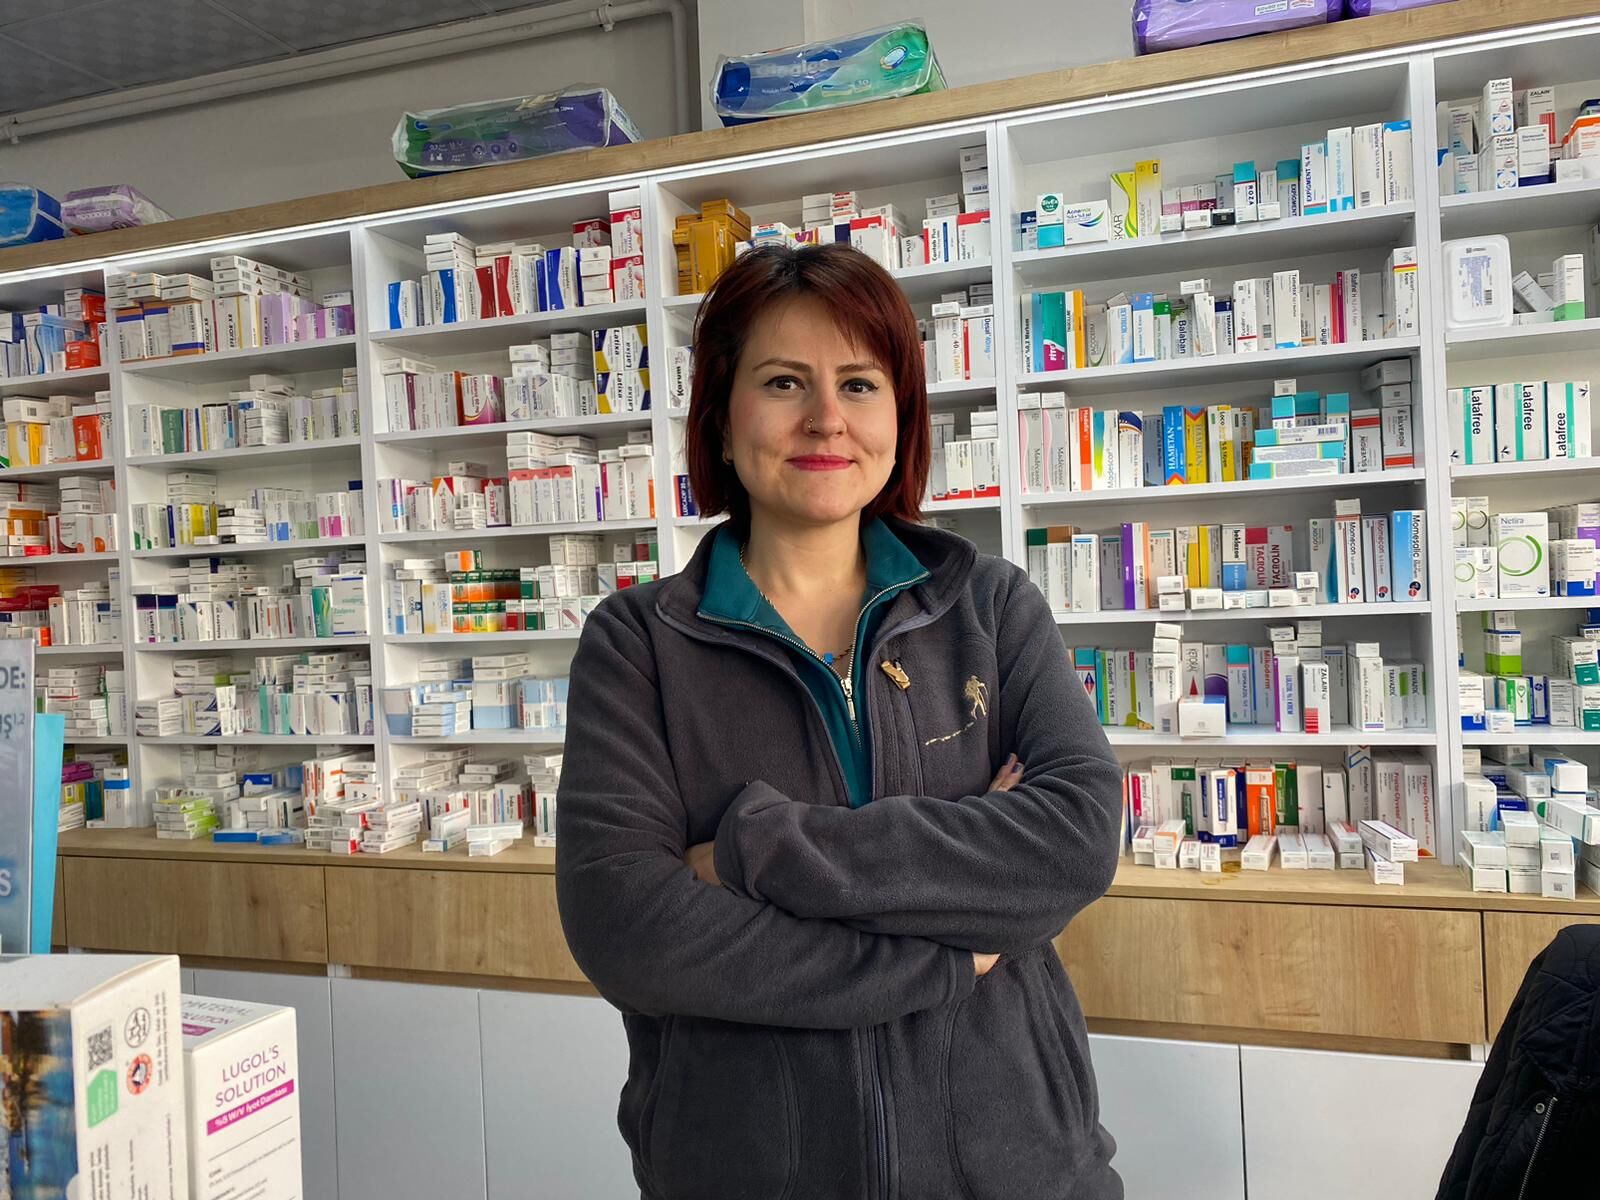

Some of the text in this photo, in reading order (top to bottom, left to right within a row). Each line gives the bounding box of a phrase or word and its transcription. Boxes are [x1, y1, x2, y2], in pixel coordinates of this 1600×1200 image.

[1248, 185, 1256, 206] ROZA
[954, 340, 959, 349] 40
[984, 318, 992, 335] Desal
[1178, 320, 1187, 354] Balaban
[1472, 390, 1483, 435] Latafree
[1523, 384, 1534, 431] Latafree
[1168, 427, 1176, 470] HAMETAN
[1556, 412, 1567, 458] Latafree
[1412, 514, 1420, 558] Momesalic
[1256, 546, 1265, 586] TACROLİN
[1272, 544, 1280, 585] TACROLİN
[222, 1045, 280, 1083] LUGOL'S
[215, 1062, 286, 1108] SOLUTION
